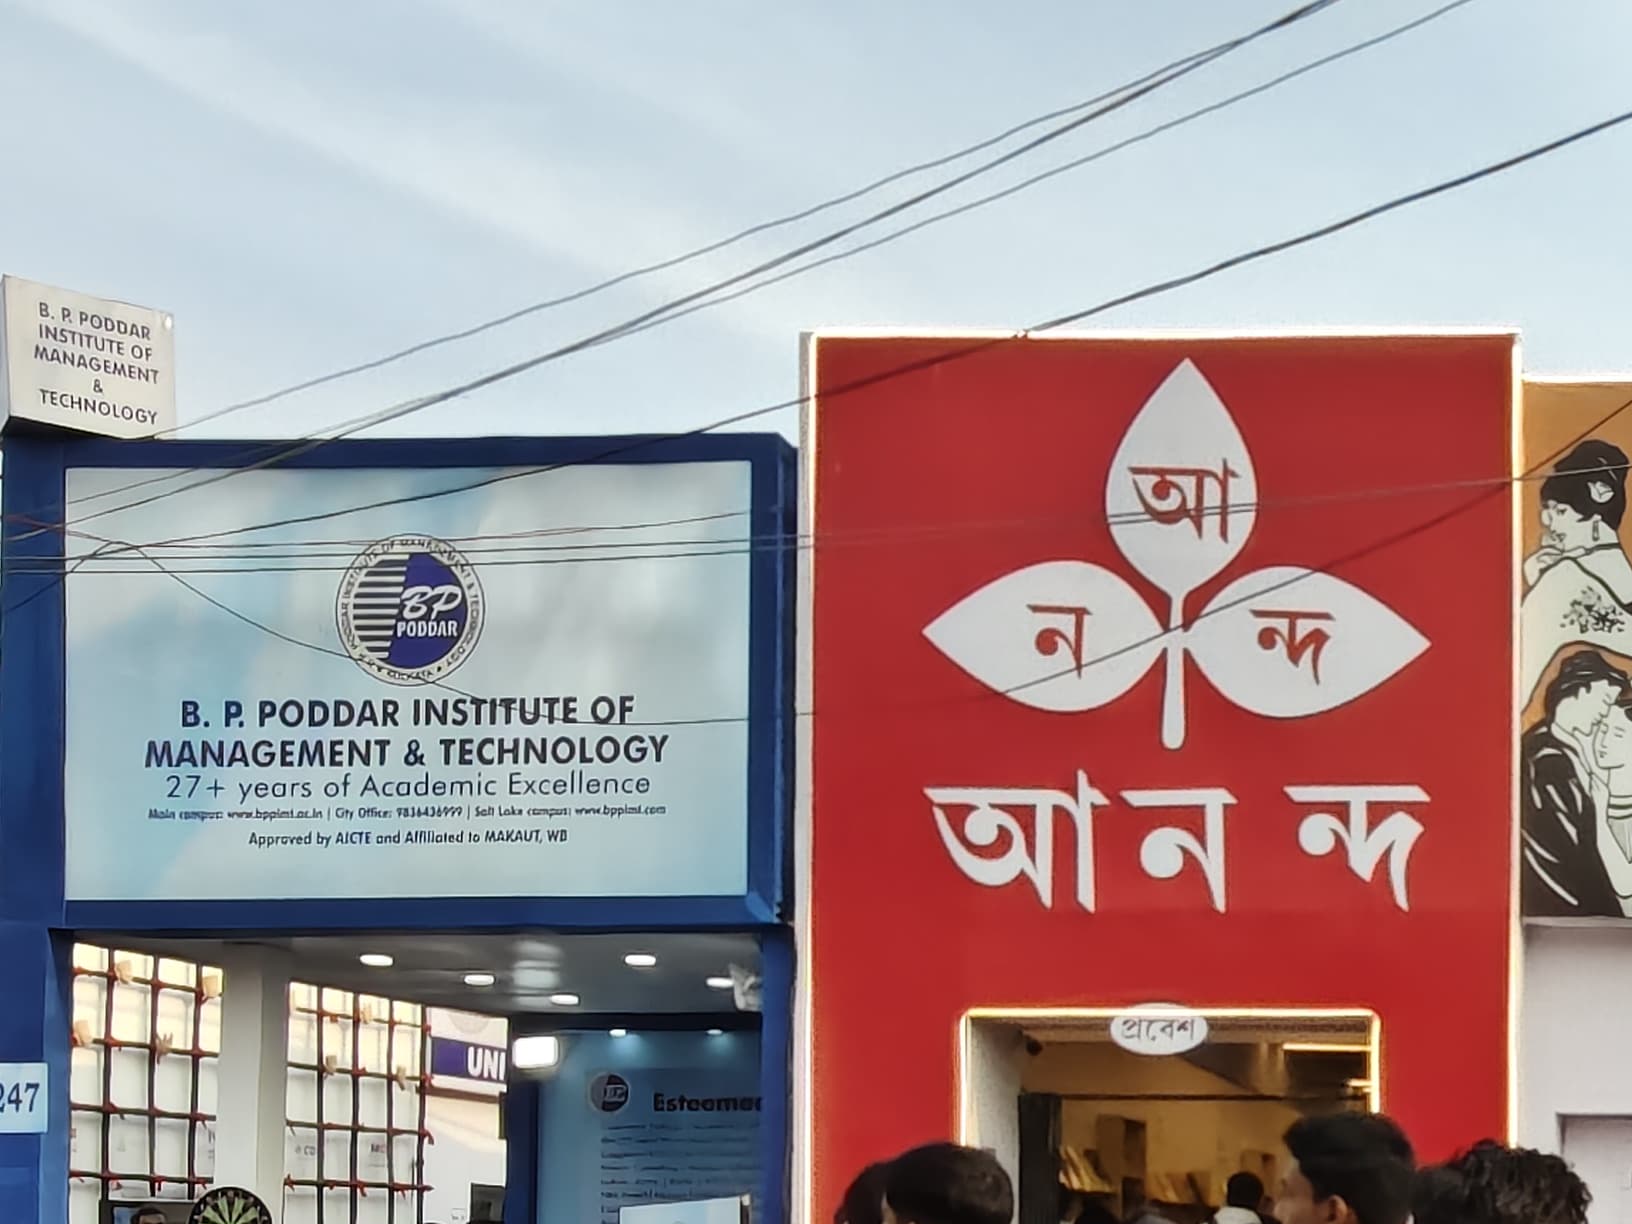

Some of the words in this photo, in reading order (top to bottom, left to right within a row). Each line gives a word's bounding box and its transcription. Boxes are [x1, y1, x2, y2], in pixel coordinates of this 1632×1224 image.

[39, 302, 55, 320] B.
[61, 307, 73, 324] P.
[79, 311, 151, 341] PODDAR
[39, 324, 125, 356] INSTITUTE
[131, 345, 153, 361] OF
[34, 344, 159, 384] MANAGEMENT
[93, 379, 103, 394] &
[39, 388, 158, 425] TECHNOLOGY
[1128, 457, 1238, 544] আ
[400, 585, 462, 619] BP
[397, 620, 458, 638] PODDAR
[1026, 603, 1091, 678] ন
[1250, 608, 1335, 685] ন্দ
[181, 700, 210, 728] B.
[224, 700, 245, 728] P.
[258, 699, 399, 728] PODDAR
[413, 697, 577, 726] INSTITUTE
[591, 695, 634, 725] OF
[145, 739, 391, 768] MANAGEMENT
[404, 739, 425, 766] &
[440, 735, 669, 766] TECHNOLOGY
[166, 775, 225, 799] 27+
[239, 781, 312, 805] years
[324, 773, 351, 798] of
[360, 772, 497, 797] Academic
[509, 770, 650, 796] Excellence
[335, 807, 353, 821] City
[499, 805, 523, 816] Lake
[249, 831, 312, 848] Approved
[317, 832, 331, 848] by
[335, 832, 371, 844] AICTE
[376, 832, 400, 844] and
[405, 830, 463, 844] Affiliated
[468, 832, 480, 844] to
[485, 829, 543, 844] MAKAUT,
[547, 829, 568, 842] WB
[923, 769, 1432, 913] আনন্দ
[1122, 1018, 1194, 1042] প্রবেশ
